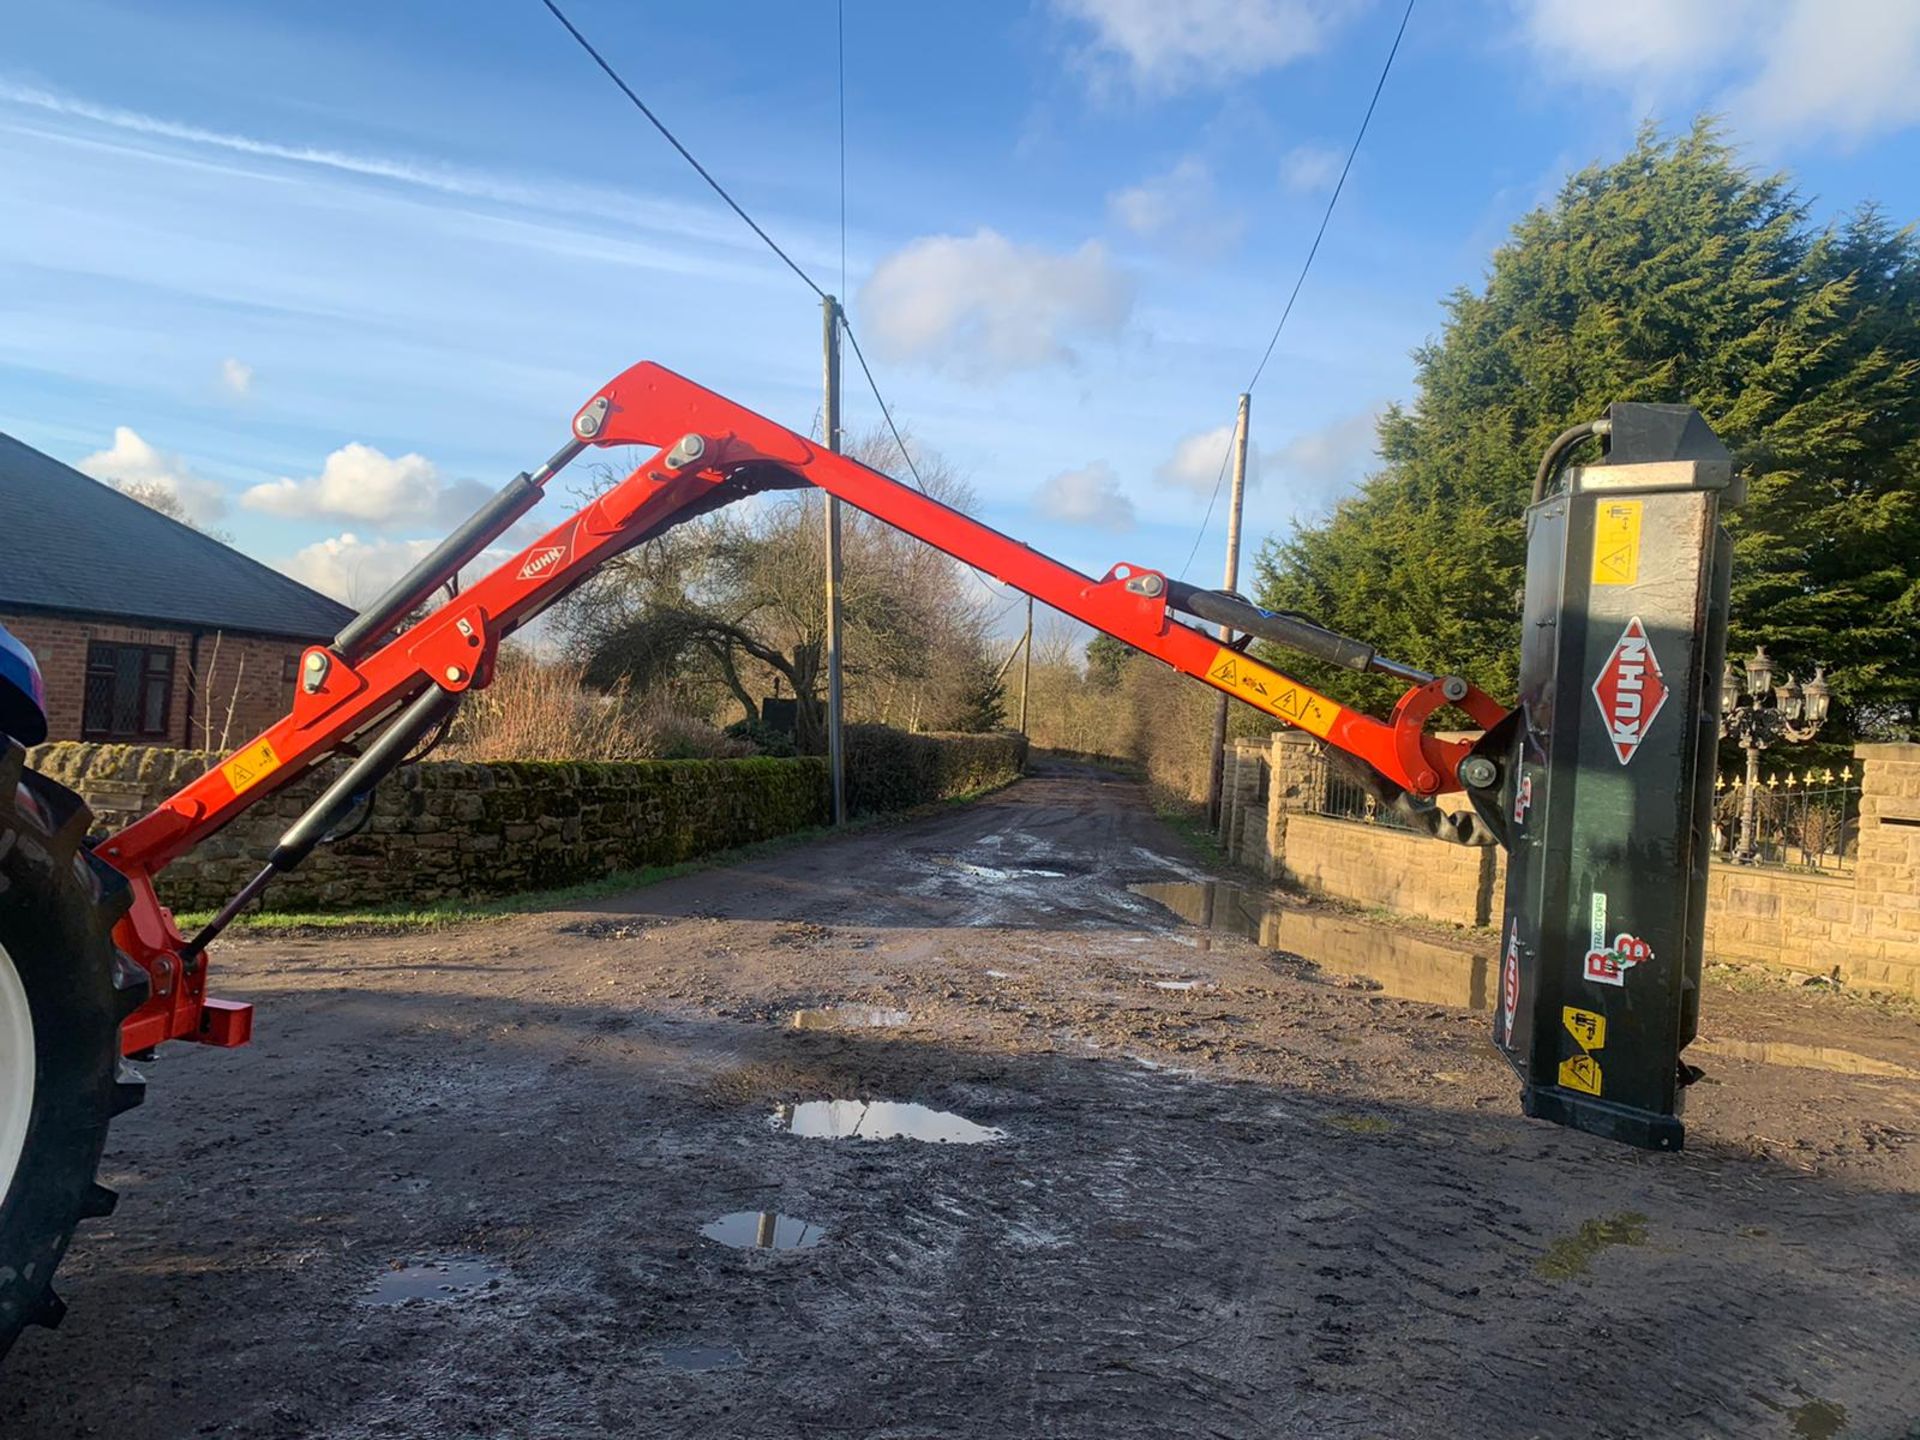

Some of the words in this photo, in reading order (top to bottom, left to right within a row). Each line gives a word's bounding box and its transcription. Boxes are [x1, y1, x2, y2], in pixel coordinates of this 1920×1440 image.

[522, 547, 561, 578] KUHN
[1613, 636, 1647, 745] KUHN
[1593, 894, 1605, 951] TRACTORS
